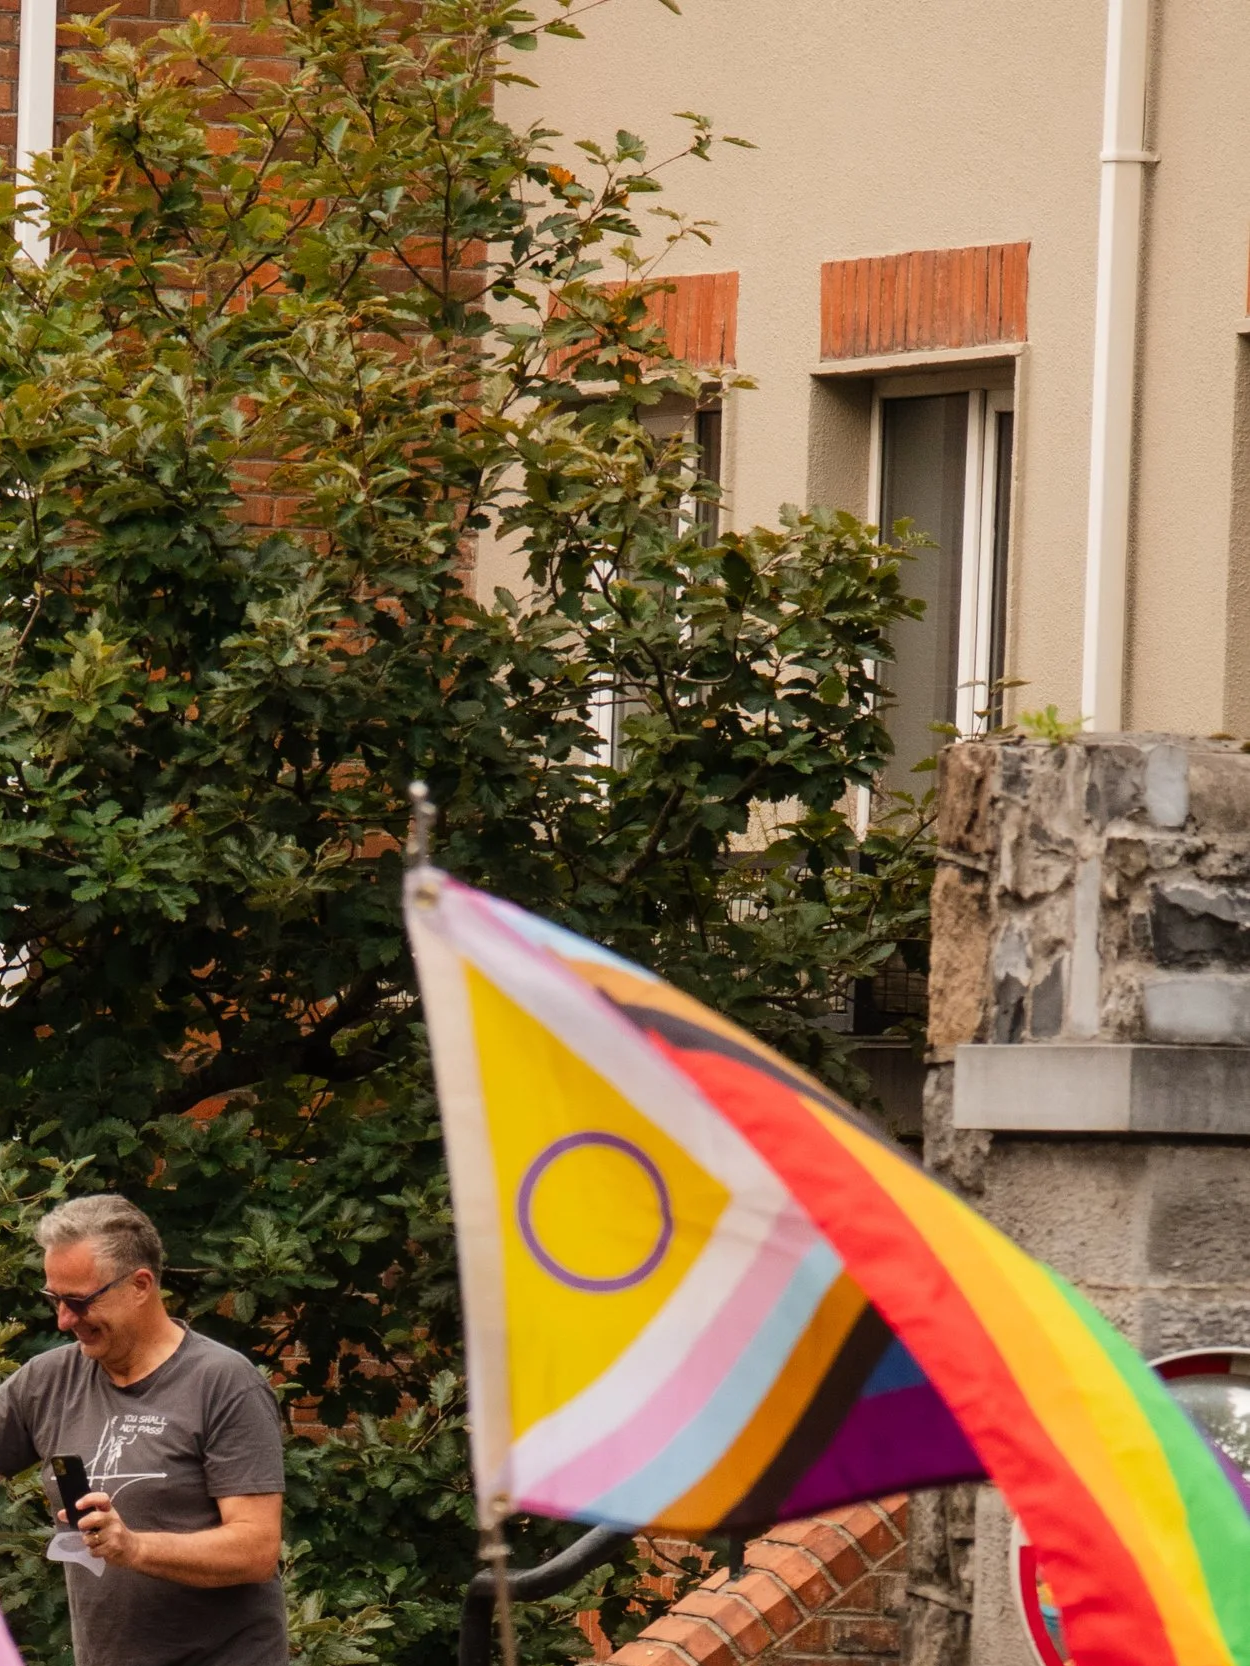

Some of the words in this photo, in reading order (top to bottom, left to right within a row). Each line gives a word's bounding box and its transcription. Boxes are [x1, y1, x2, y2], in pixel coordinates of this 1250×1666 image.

[124, 1414, 138, 1422] YOU
[138, 1414, 168, 1425] SHALL
[119, 1424, 137, 1433] NOT
